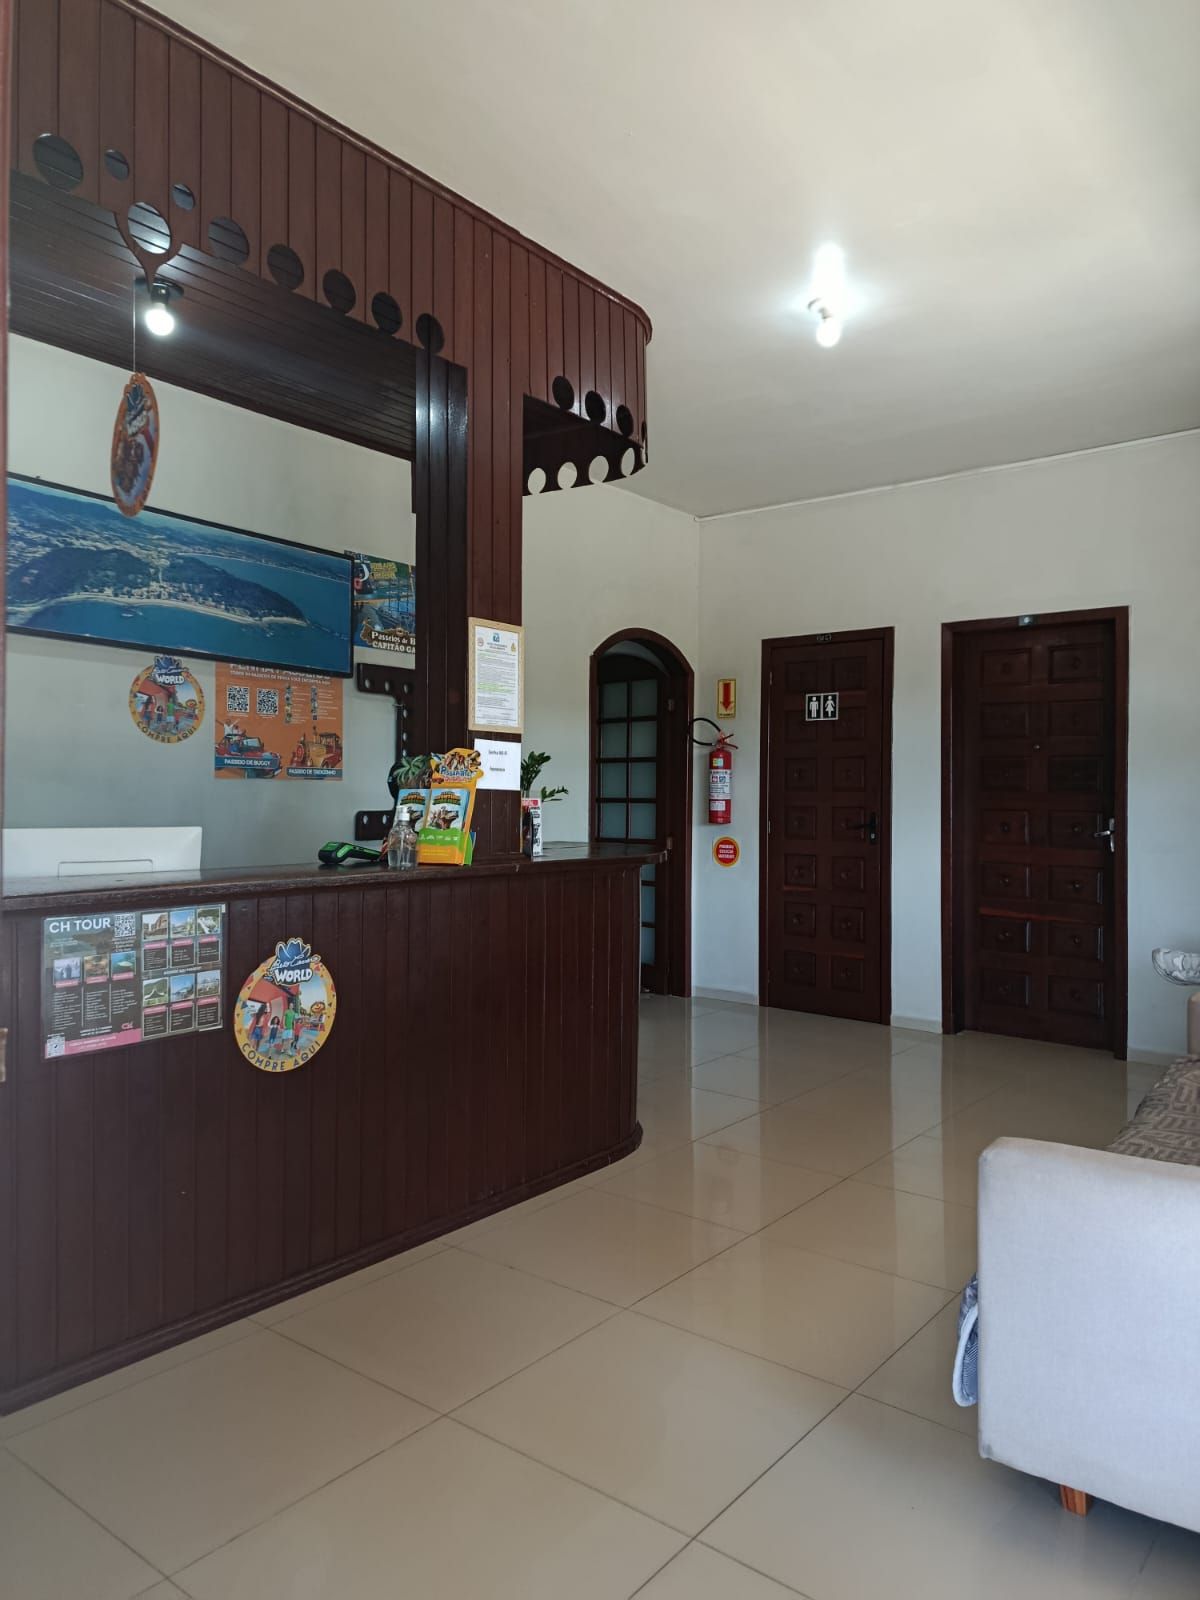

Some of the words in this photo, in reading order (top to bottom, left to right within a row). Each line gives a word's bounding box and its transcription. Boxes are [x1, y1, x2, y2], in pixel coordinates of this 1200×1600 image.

[371, 631, 401, 643] Passeios
[155, 673, 185, 685] WORLD
[137, 721, 172, 744] COMPRE
[176, 725, 197, 743] AQUI
[49, 920, 71, 934] CH
[75, 916, 111, 932] TOUR
[274, 968, 313, 983] WORLD
[241, 1041, 286, 1071] COMPRE
[292, 1040, 321, 1069] AQUI
